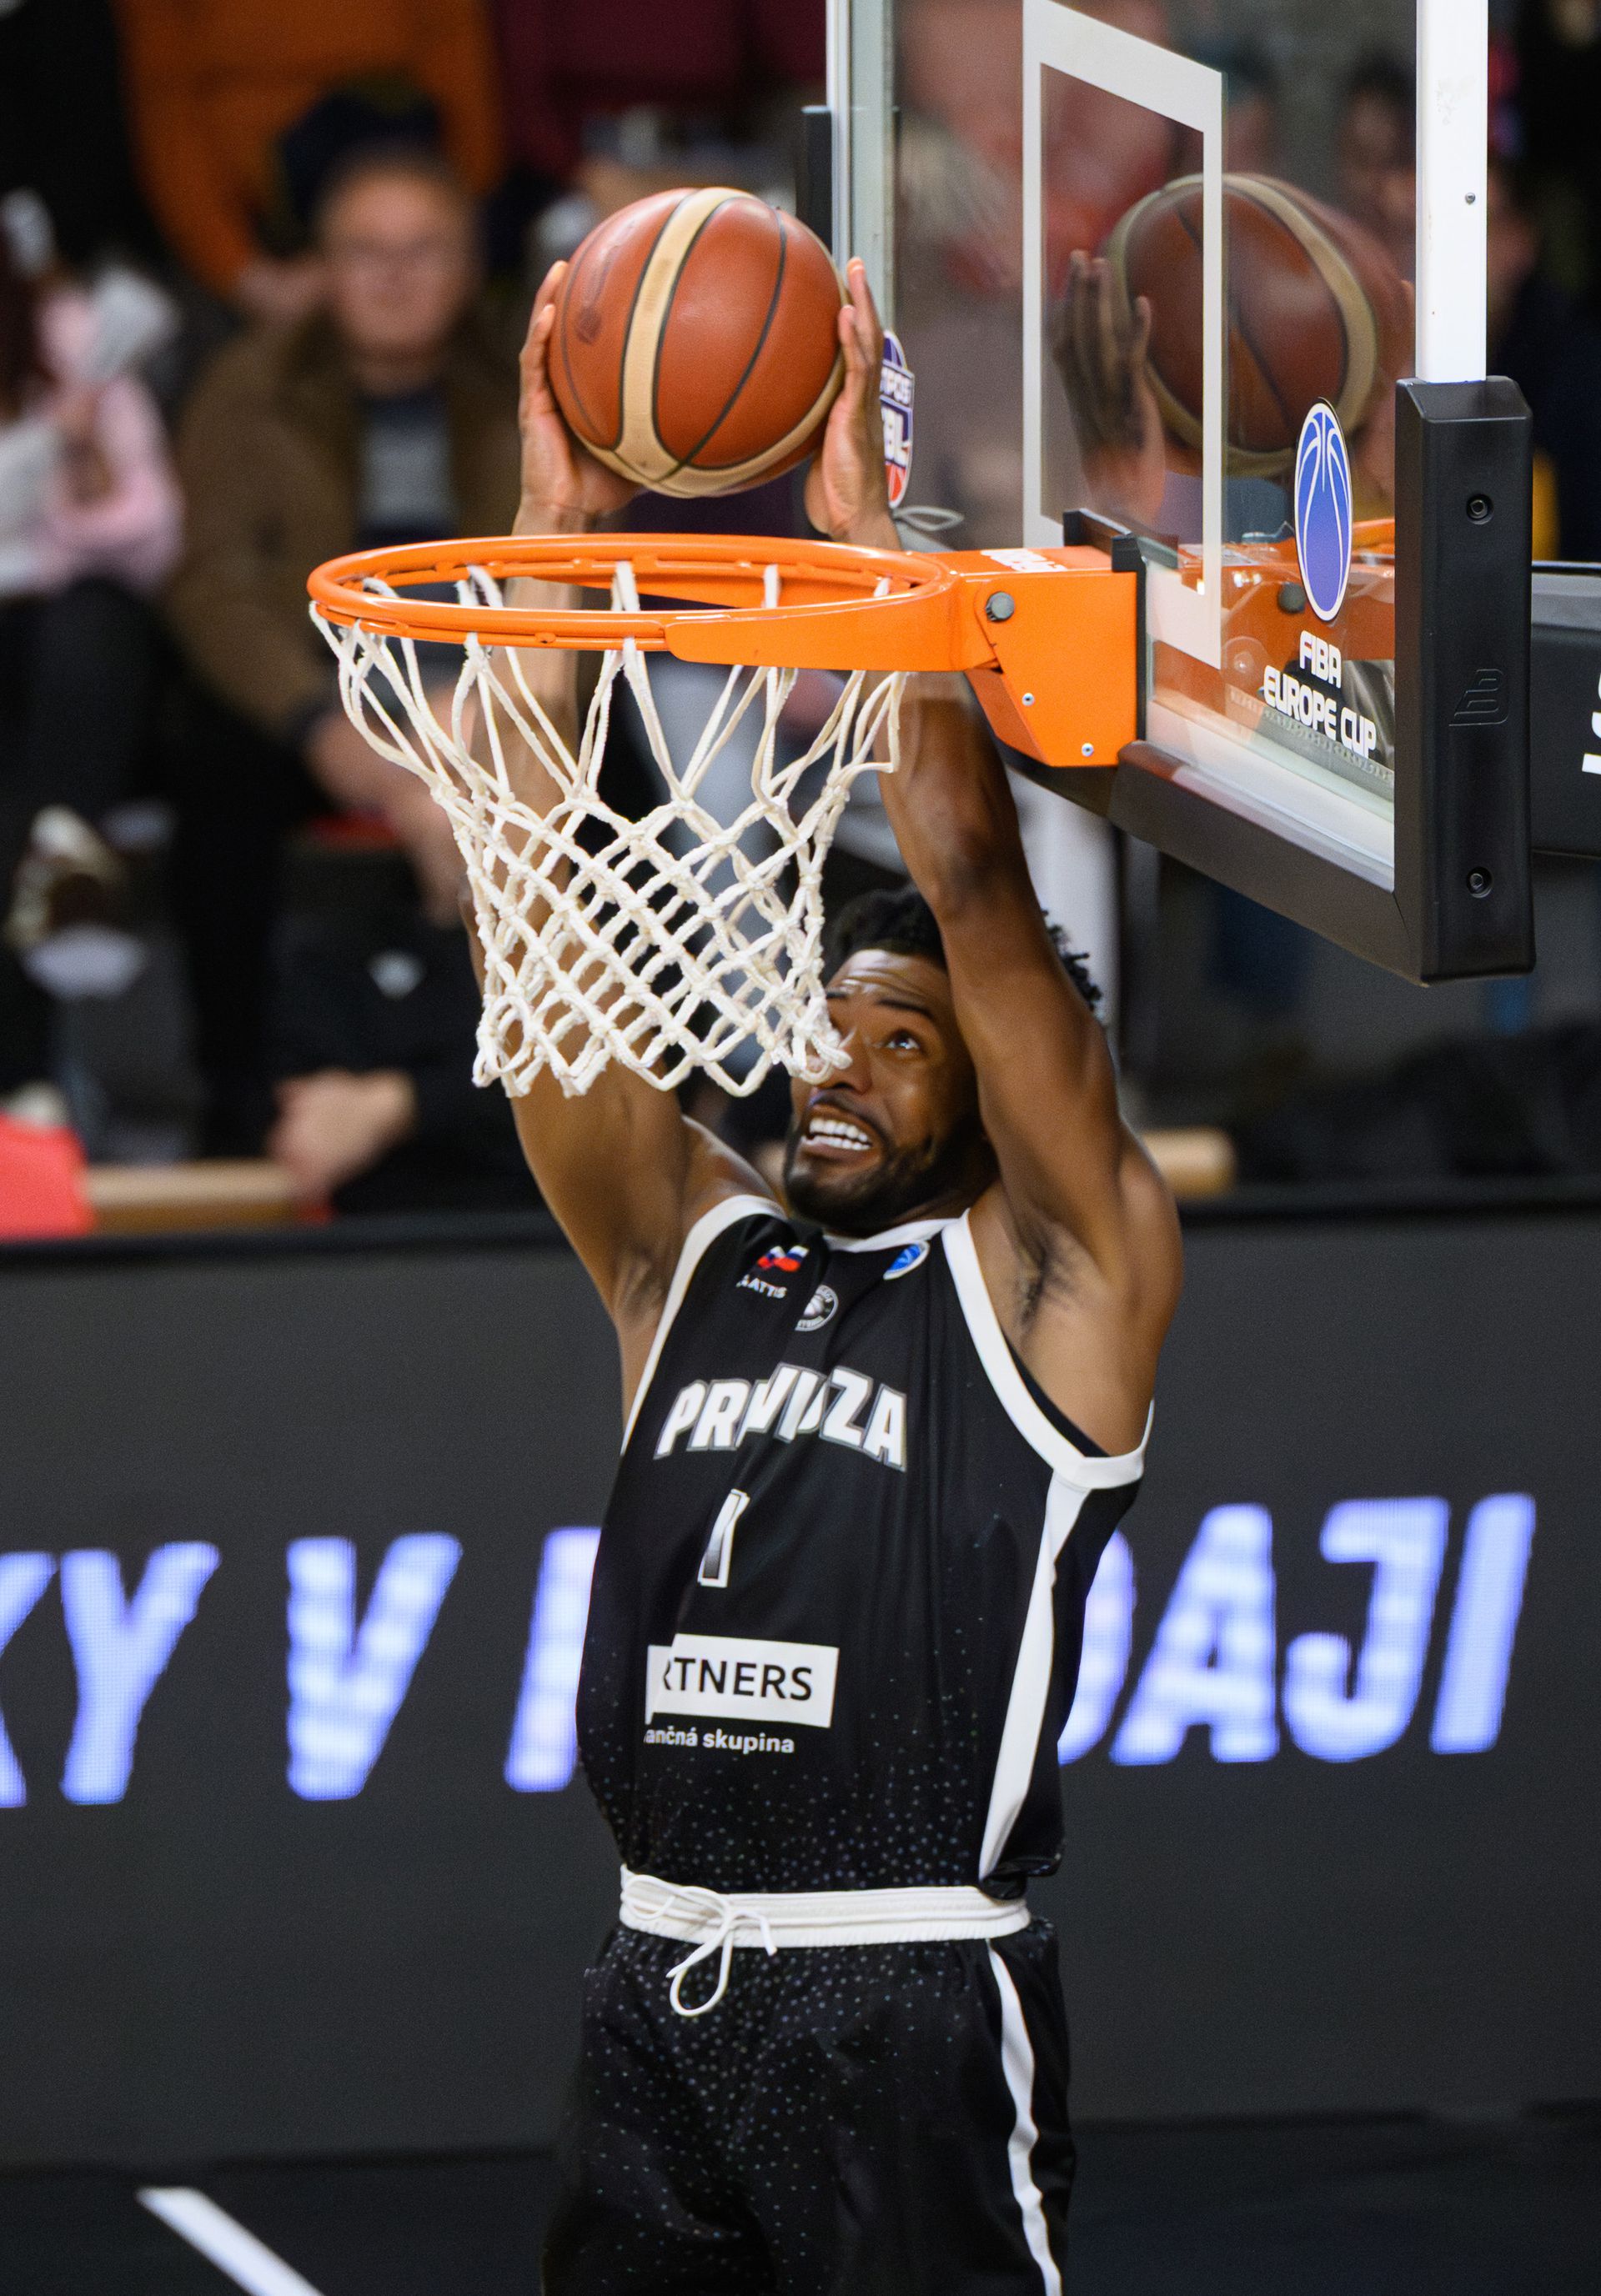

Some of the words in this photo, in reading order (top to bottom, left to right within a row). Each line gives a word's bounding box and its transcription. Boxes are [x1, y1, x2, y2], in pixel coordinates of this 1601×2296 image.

[1299, 630, 1342, 689] FIBA
[1263, 664, 1338, 741] EUROPE
[1340, 707, 1377, 759] CUP
[286, 1532, 464, 1802] V
[643, 1725, 699, 1747] ančná
[703, 1728, 795, 1755] skupina
